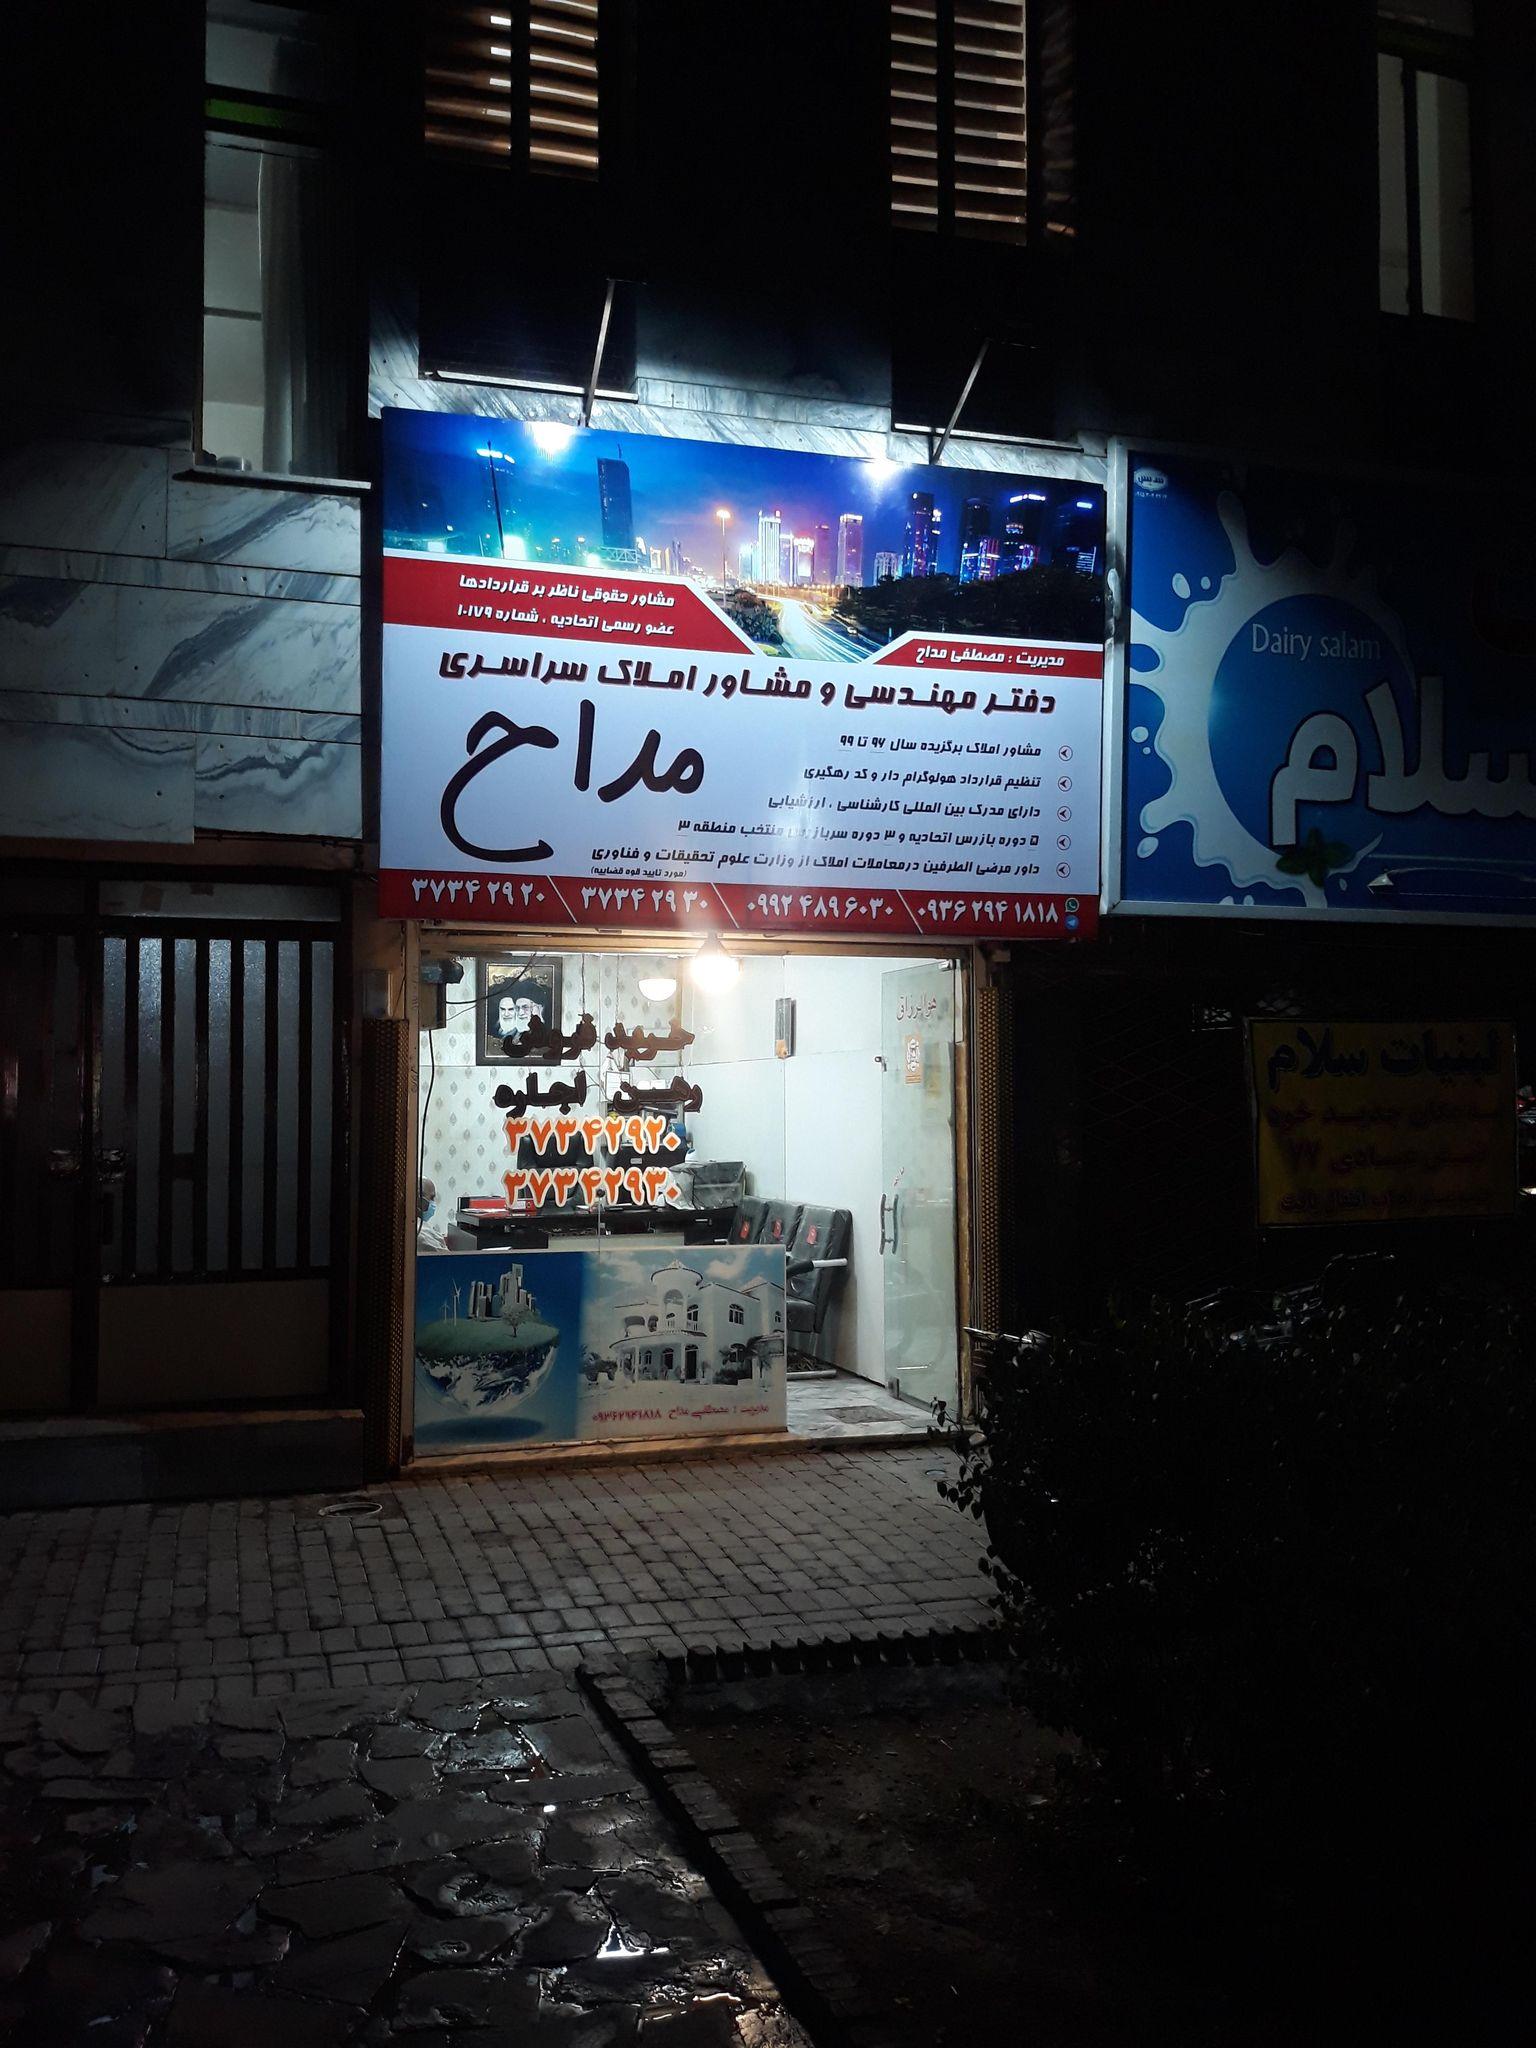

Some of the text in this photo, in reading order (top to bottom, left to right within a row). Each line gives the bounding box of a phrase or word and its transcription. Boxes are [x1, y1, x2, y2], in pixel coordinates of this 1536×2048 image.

[459, 574, 675, 607] مشاور حقوقی ناظر بر قراردادها
[495, 607, 539, 623] شماره
[550, 613, 599, 628] اتحادیه
[601, 619, 642, 633] رسمی
[645, 620, 675, 635] عضو
[1252, 623, 1381, 660] Dairy salam
[916, 646, 948, 664] مداح
[950, 648, 1005, 664] مصطفی
[1015, 652, 1065, 667] مدیریت
[439, 650, 1056, 716] دفتر مهندسی و مشاور املاک سراسری
[840, 735, 1042, 757] مشاور املاک برگزیده سال ۹۶ تا ۹۹
[439, 698, 705, 864] مداح
[803, 765, 1041, 791] تنظیم قرارداد هولوگرام دار و کد رهگیری
[768, 793, 826, 810] ارزشیابی
[837, 797, 900, 812] کارشناسی
[903, 800, 941, 815] المللی
[944, 803, 965, 817] بین
[968, 803, 1004, 816] مدرک
[1007, 805, 1041, 819] دارای
[678, 819, 691, 831] ۳
[693, 821, 736, 834] منطقه
[740, 823, 784, 837] منتخب
[851, 830, 880, 842] دوره
[884, 829, 896, 841] ۳
[898, 832, 906, 843] و
[909, 830, 952, 845] اتحادیه
[955, 833, 996, 847] بازرس
[999, 834, 1026, 847] دوره
[1029, 835, 1039, 846] ۵
[592, 847, 640, 862] فناوری
[643, 850, 651, 862] و
[655, 848, 714, 865] تحقیقات
[718, 853, 750, 868] علوم
[753, 853, 794, 867] وزارت
[797, 855, 810, 868] از
[812, 855, 849, 869] املاک
[625, 867, 641, 877] قوه
[642, 868, 662, 879] تایید
[923, 859, 973, 874] الطرفین
[976, 861, 1011, 875] مرضی
[1014, 863, 1040, 876] داور
[500, 1014, 695, 1061] خرید فروش
[1267, 1027, 1499, 1092] لبنیات سلام
[492, 1070, 703, 1118] رهن اجاره
[503, 1115, 681, 1155] ۳۷۳۴۲۹۲۰
[502, 1166, 681, 1208] ۳۷۳۴۲۹۳۰
